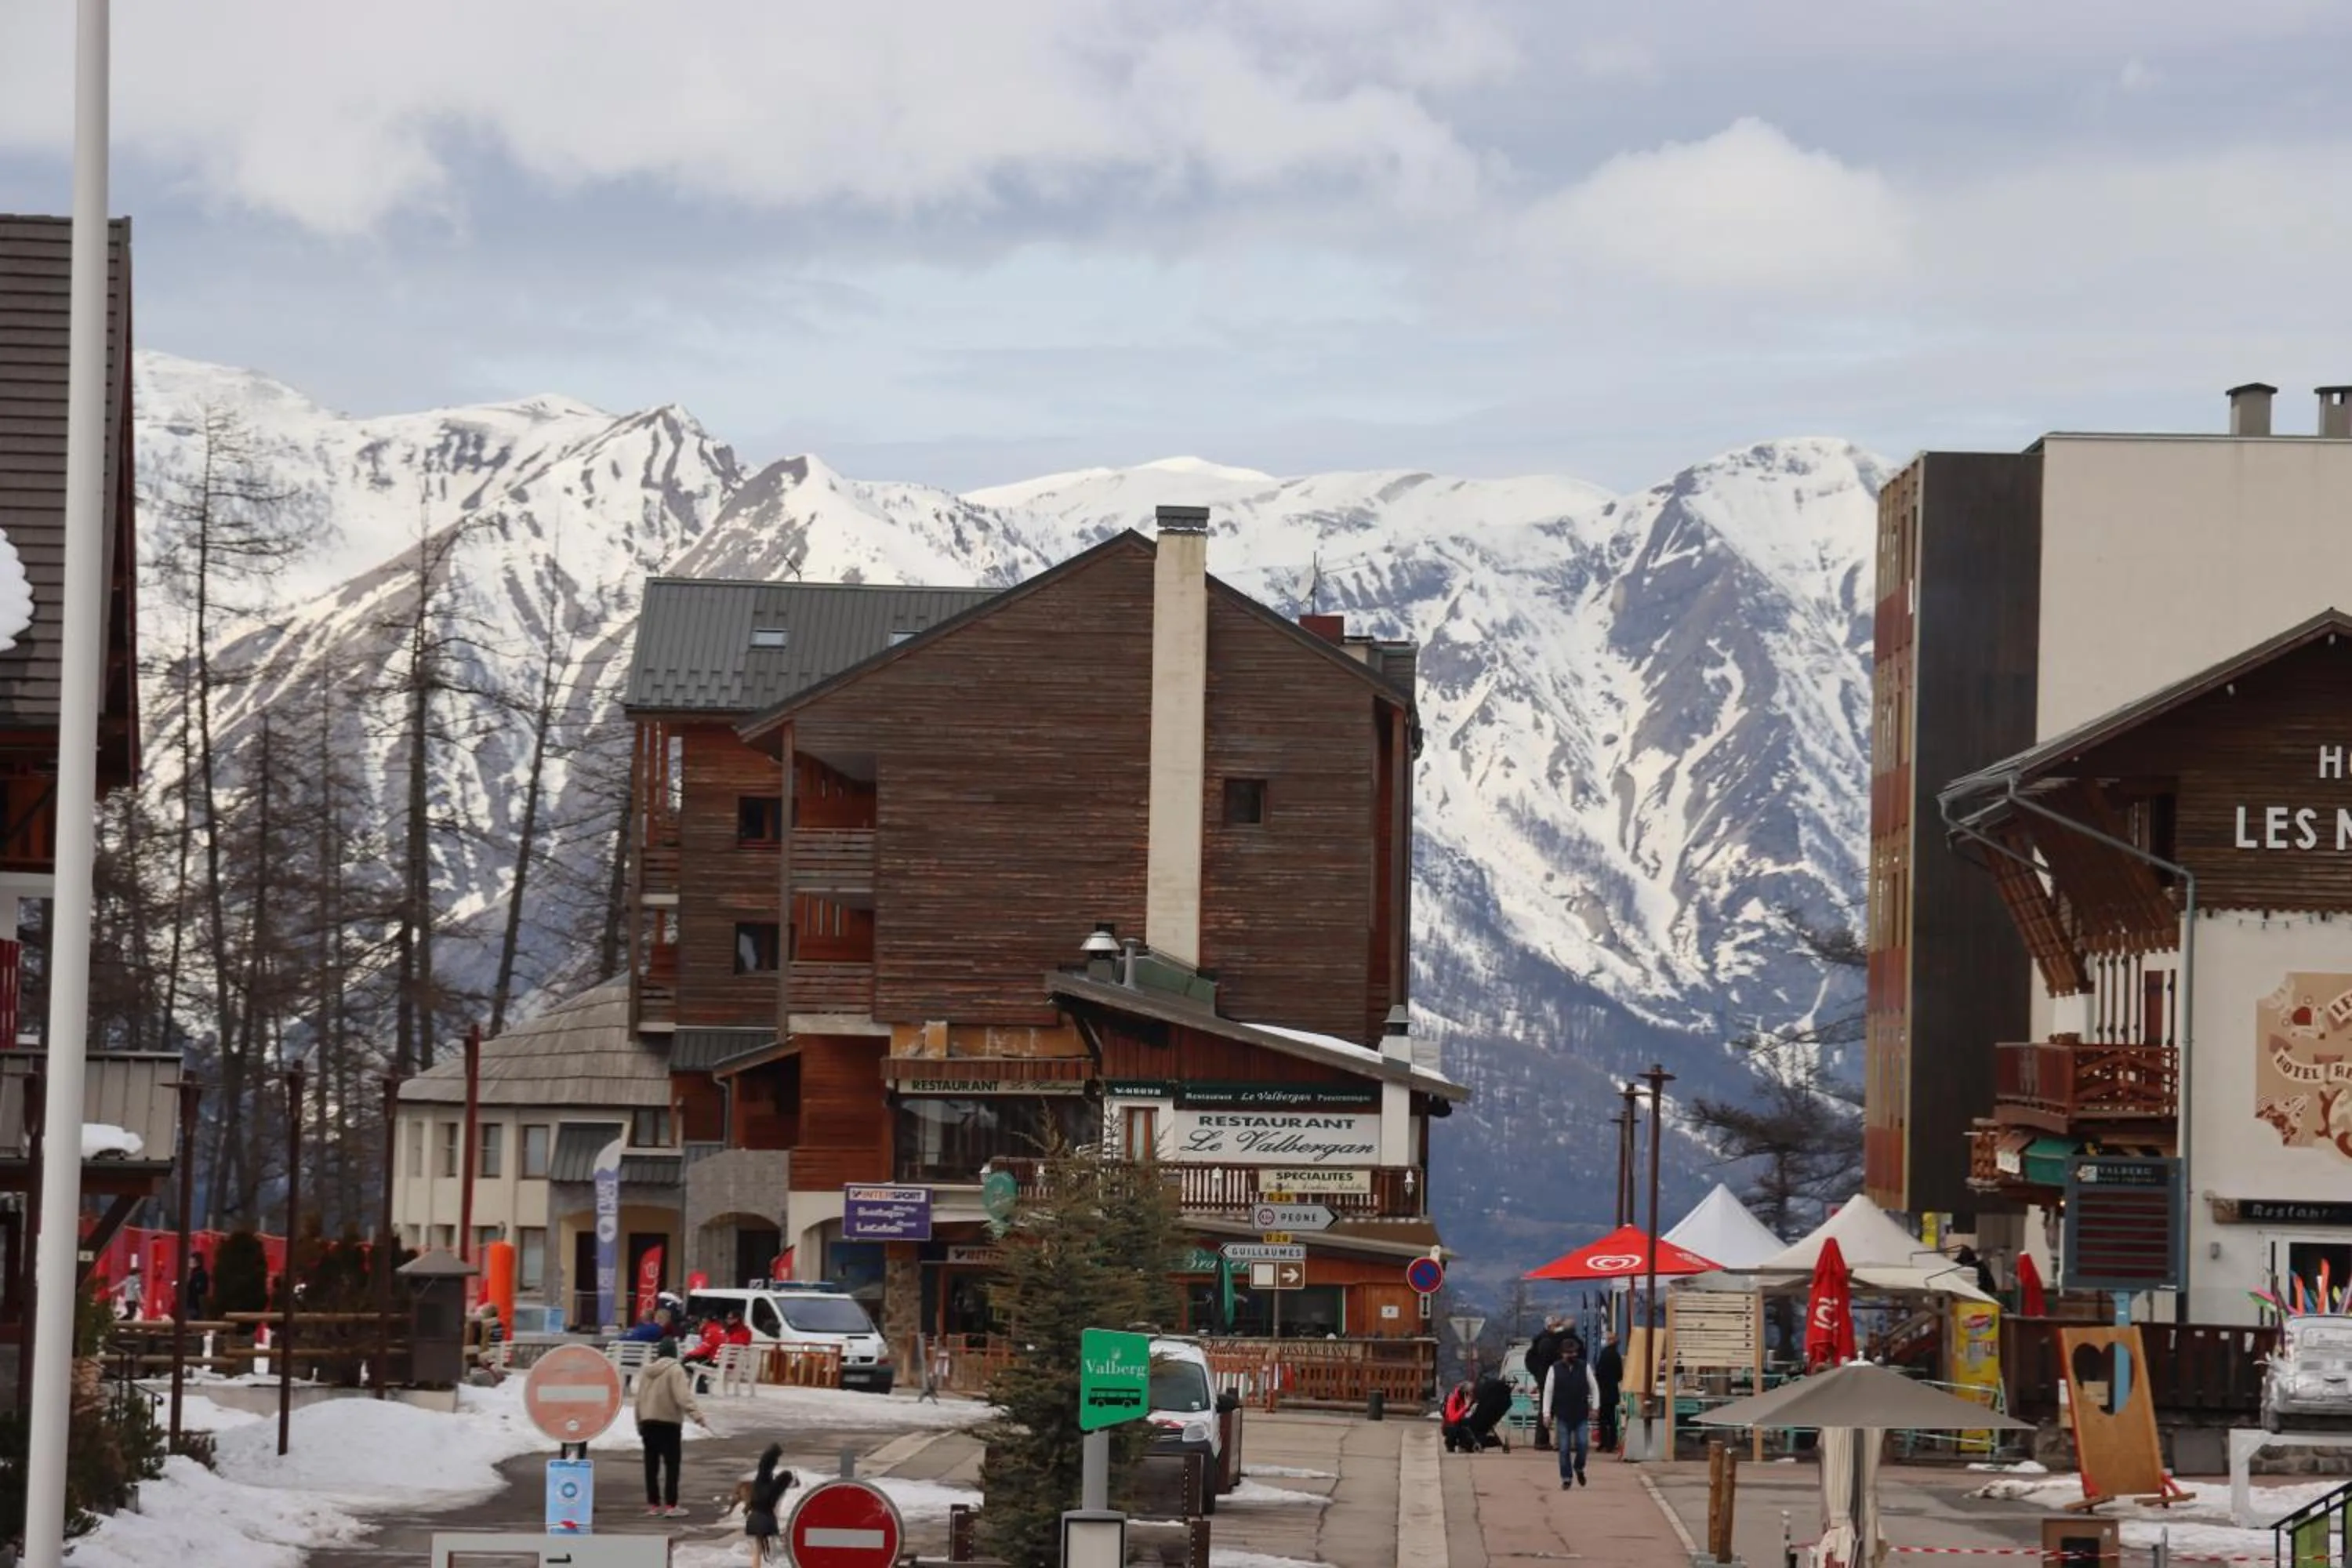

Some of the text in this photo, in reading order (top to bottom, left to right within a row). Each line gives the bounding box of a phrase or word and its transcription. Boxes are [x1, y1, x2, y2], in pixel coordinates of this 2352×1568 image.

[2319, 745, 2352, 779] H
[2236, 806, 2318, 850] LES
[912, 1080, 1000, 1092] RESTAURANT
[1240, 1092, 1255, 1101] Le
[1199, 1116, 1356, 1130] RESTAURANT
[1179, 1129, 1375, 1162] Le Valbergan
[1276, 1171, 1354, 1181] SPECIALITES
[861, 1189, 922, 1200] INTERSPORT
[1231, 1246, 1301, 1257] GUILLAUMES
[1085, 1359, 1147, 1380] Valberg
